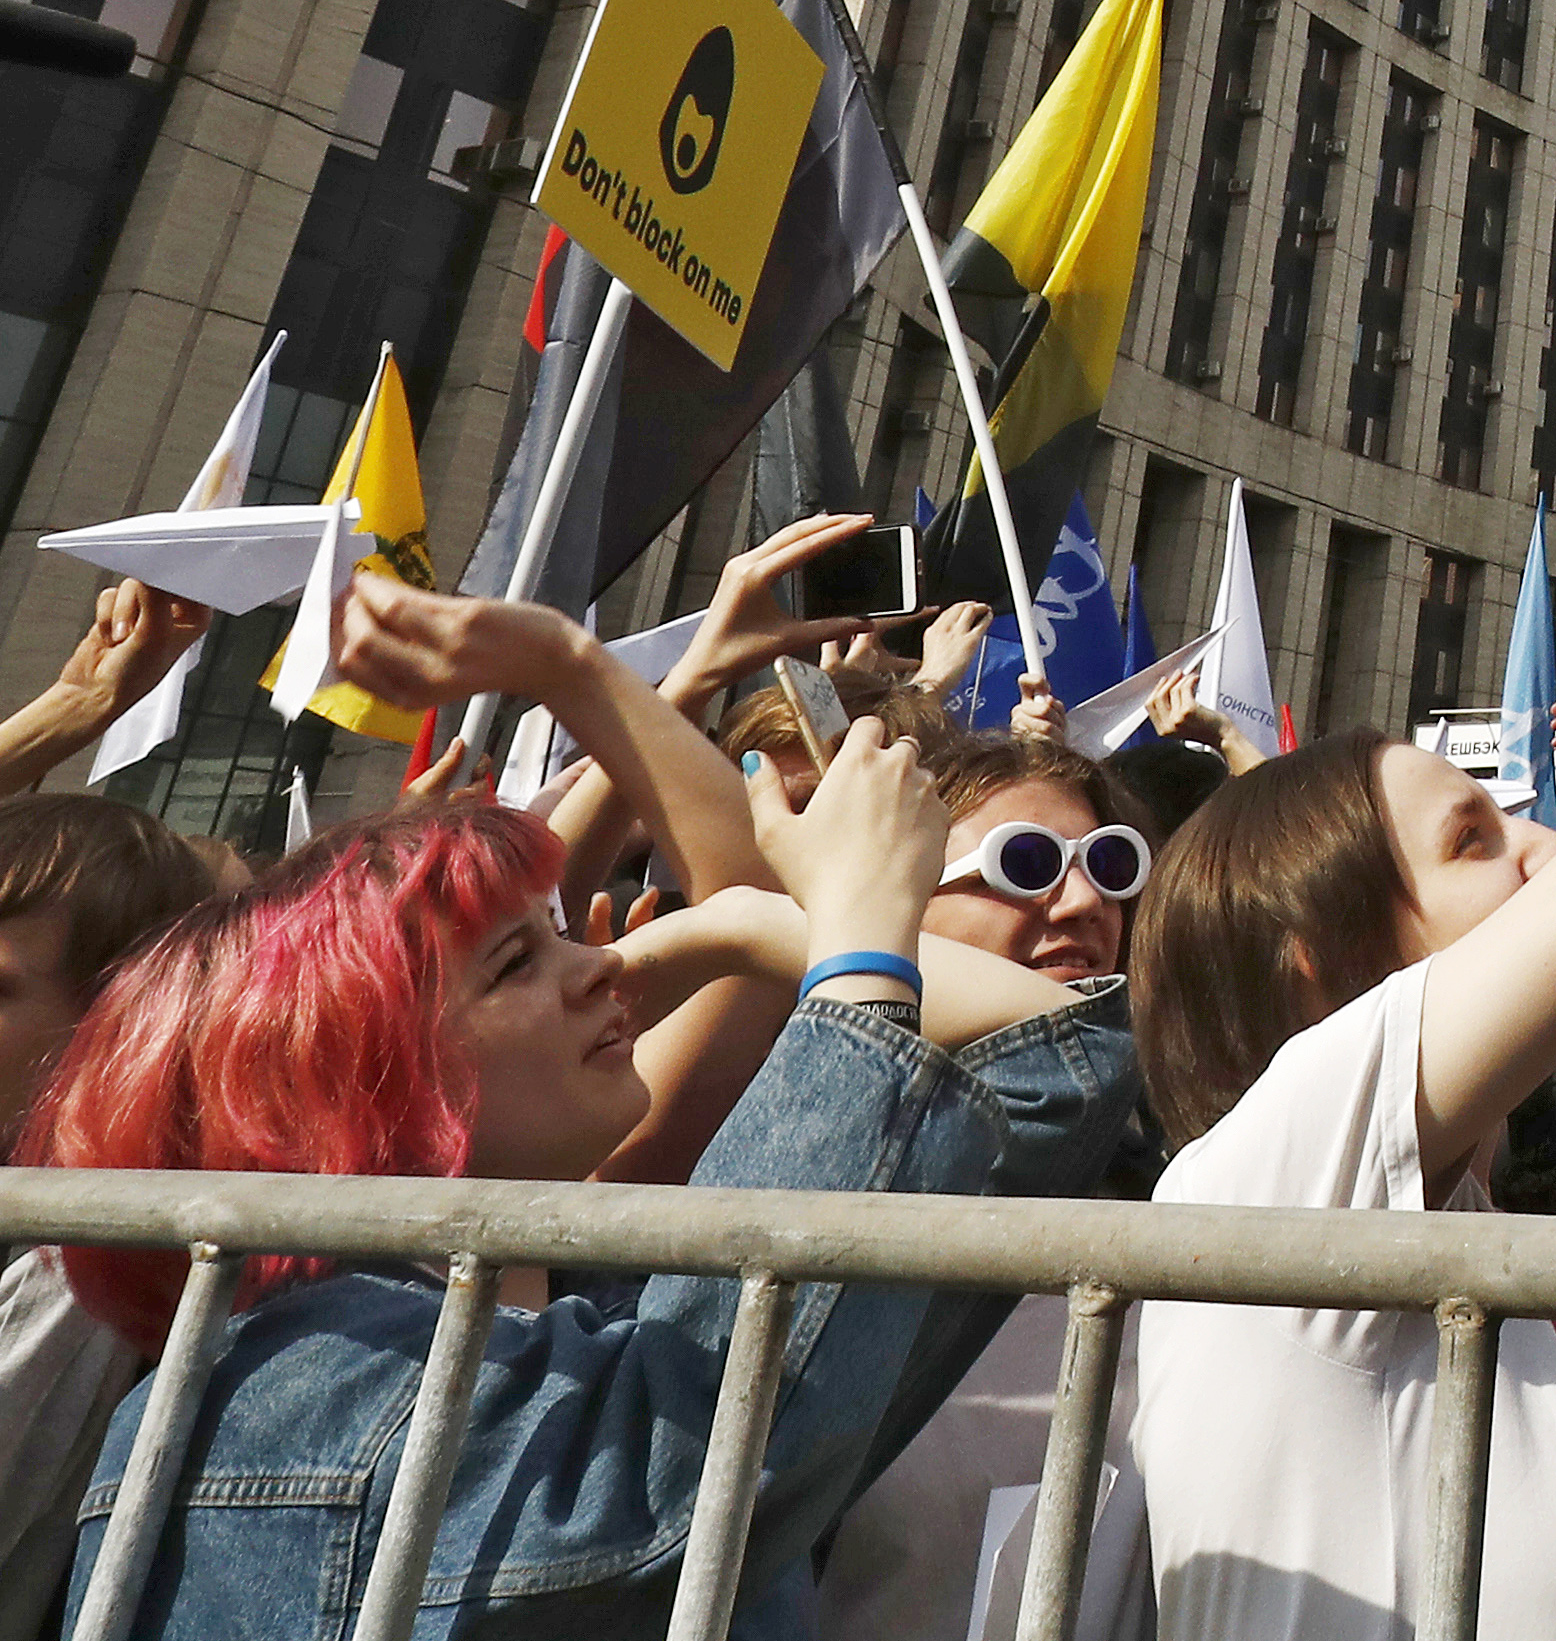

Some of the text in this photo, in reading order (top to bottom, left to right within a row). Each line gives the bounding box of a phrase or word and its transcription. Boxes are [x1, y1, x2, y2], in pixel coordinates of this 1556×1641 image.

[561, 128, 743, 326] Don't block on me
